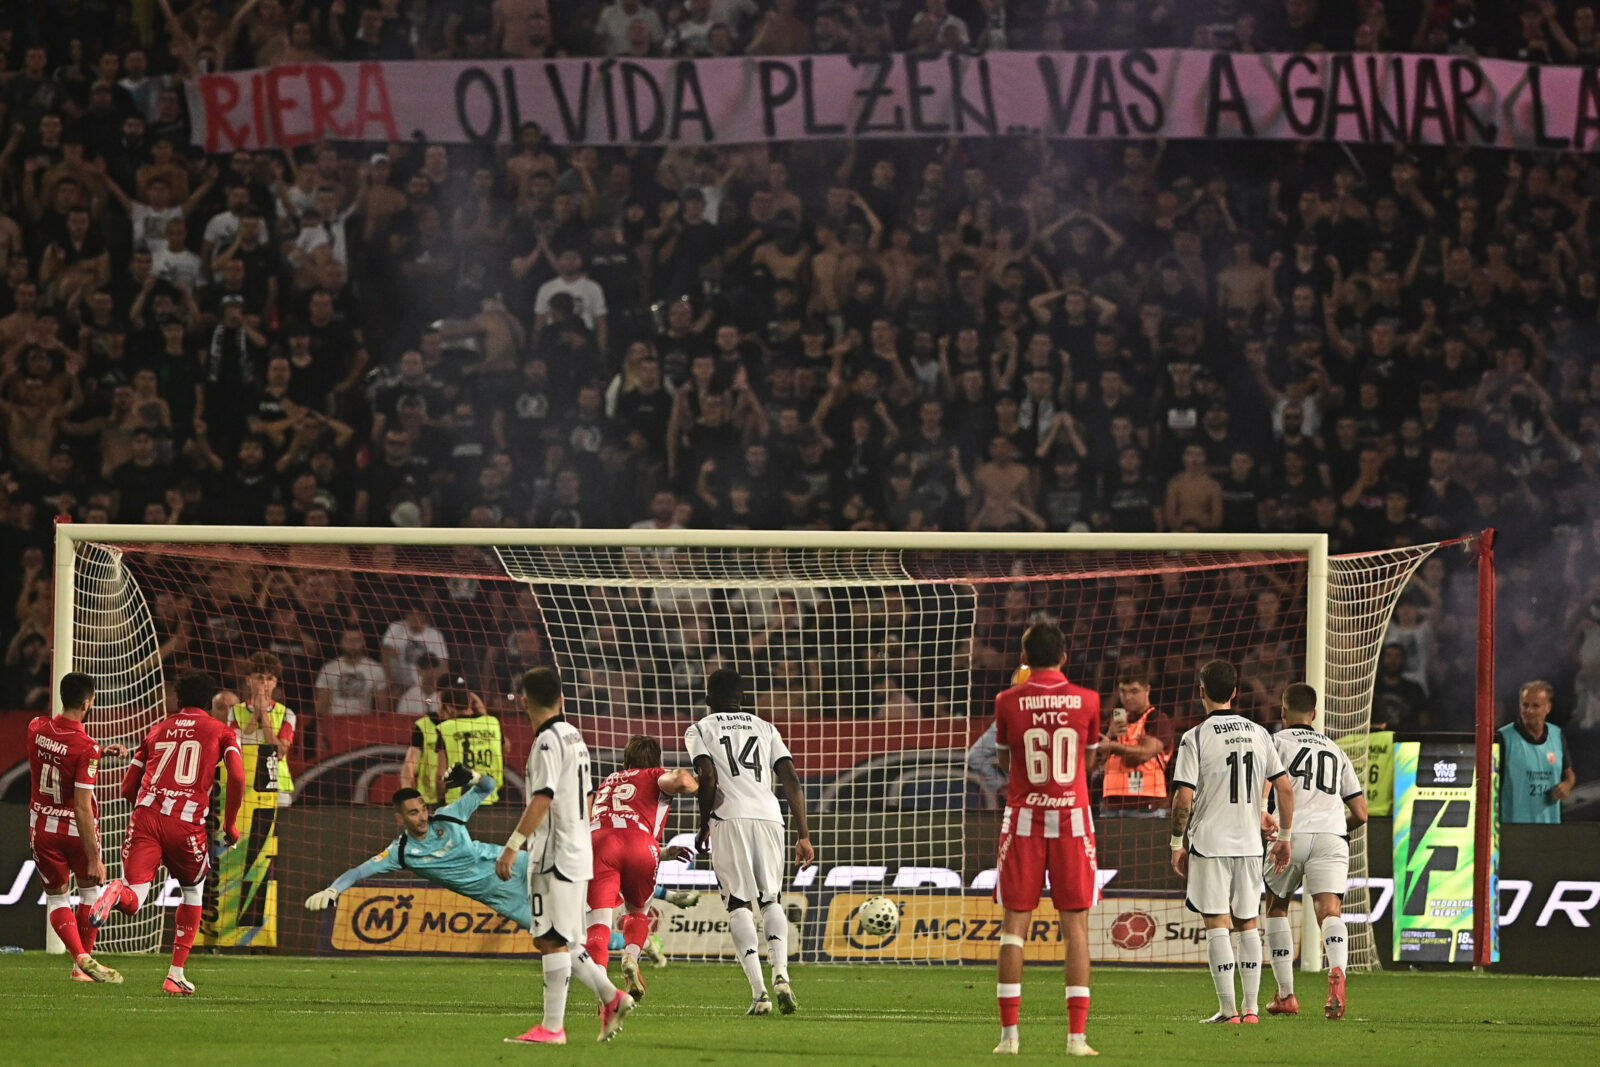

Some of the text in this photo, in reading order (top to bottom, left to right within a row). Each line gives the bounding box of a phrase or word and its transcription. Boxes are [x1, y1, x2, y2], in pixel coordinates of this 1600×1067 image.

[198, 61, 400, 153] RIERA
[1037, 49, 1164, 135] VAS
[1204, 53, 1256, 136] A
[1281, 54, 1497, 144] GANAR
[1528, 63, 1600, 150] LA
[151, 740, 202, 786] 70
[719, 735, 762, 783] 14
[1023, 727, 1078, 785] 60
[1226, 751, 1253, 803] 11
[1289, 746, 1338, 795] 40
[39, 763, 62, 804] 4
[592, 783, 638, 815] 22
[914, 918, 1062, 942] MOZZRT
[1218, 963, 1233, 972] FKP
[1241, 961, 1257, 969] FKP
[1272, 949, 1289, 957] FKP
